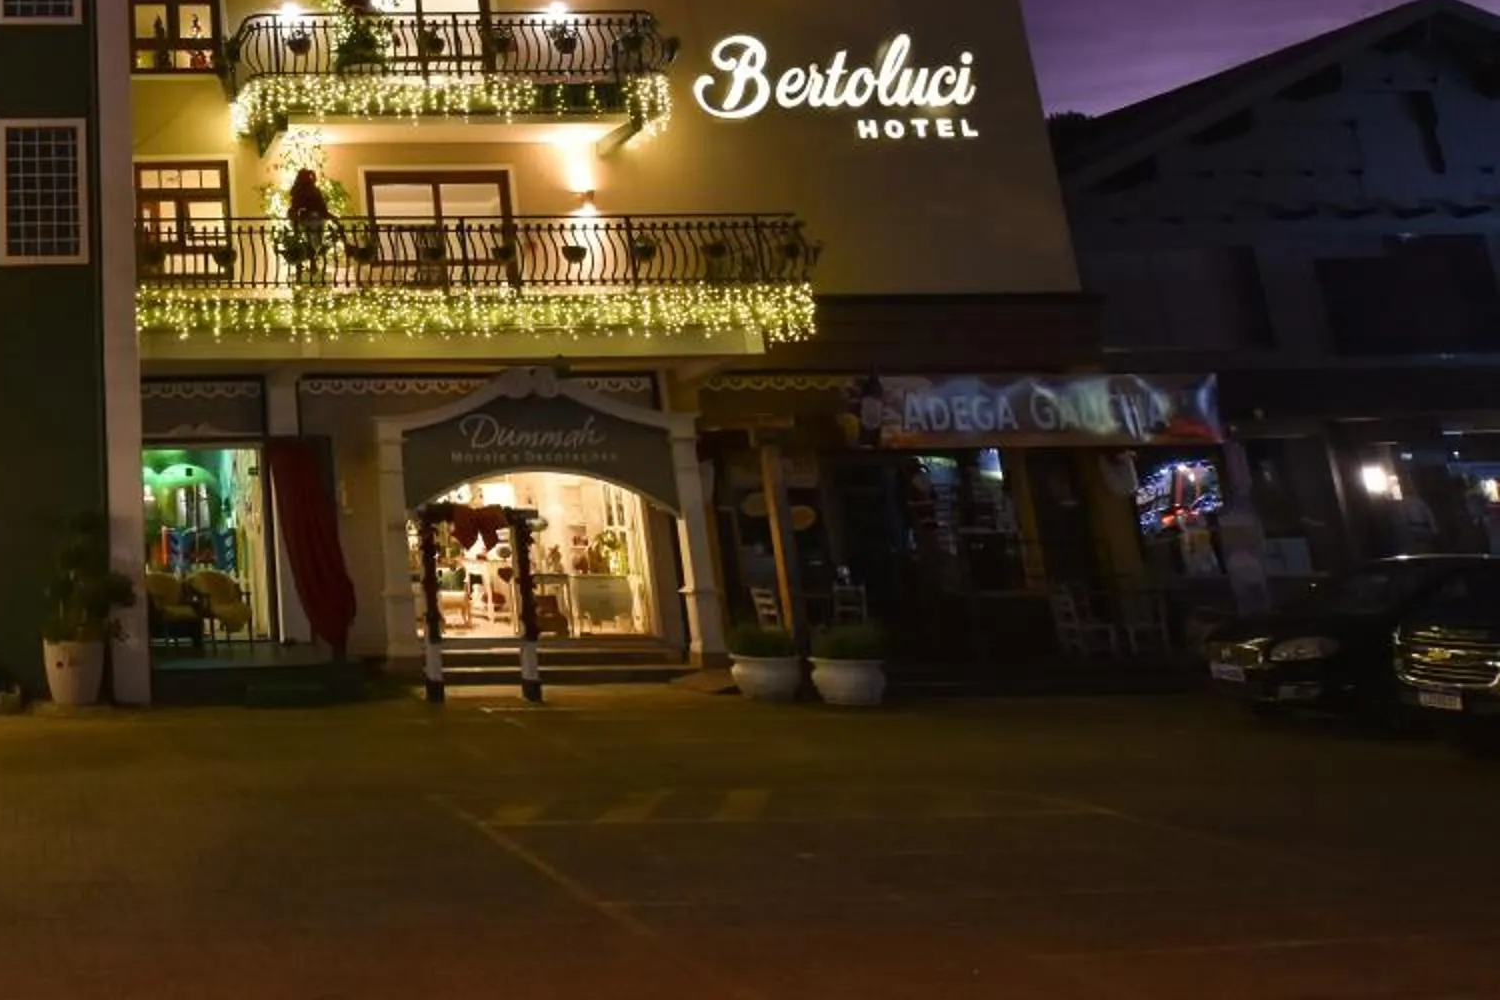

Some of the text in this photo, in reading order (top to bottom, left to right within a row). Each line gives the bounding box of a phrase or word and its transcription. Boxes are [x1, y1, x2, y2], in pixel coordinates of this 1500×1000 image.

[692, 33, 977, 119] Bertoluci
[857, 119, 980, 140] HOTEL
[903, 390, 1019, 432] ADEGA
